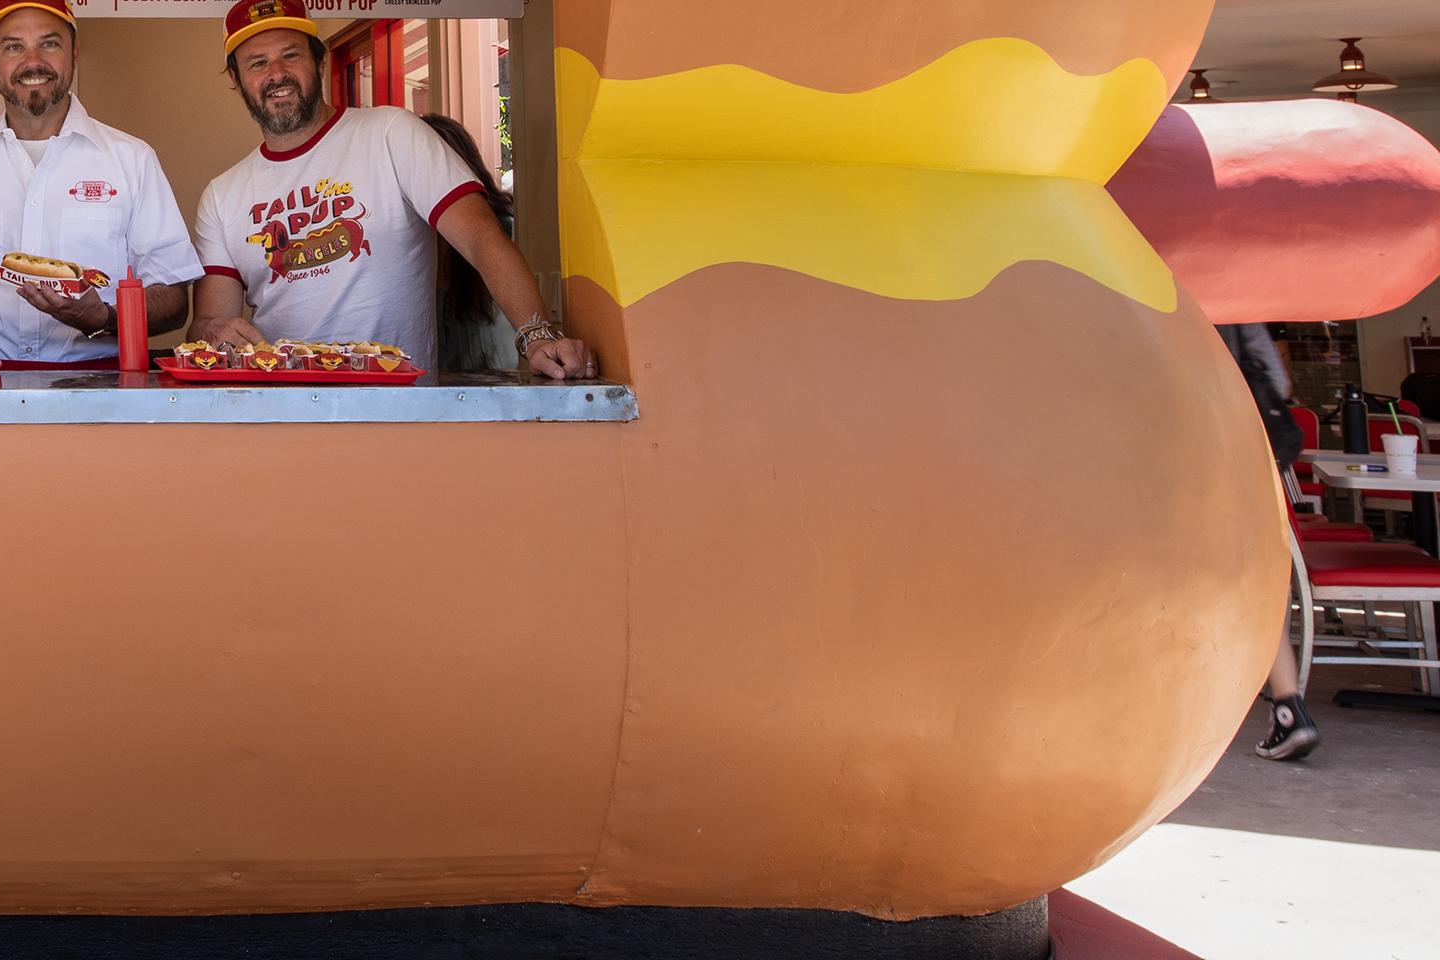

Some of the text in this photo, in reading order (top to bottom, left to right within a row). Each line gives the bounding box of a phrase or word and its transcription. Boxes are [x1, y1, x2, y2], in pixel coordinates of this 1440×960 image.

[249, 186, 319, 224] TAIL
[288, 196, 355, 235] PUP
[297, 235, 348, 264] ANGELES
[287, 266, 330, 283] Since 1946
